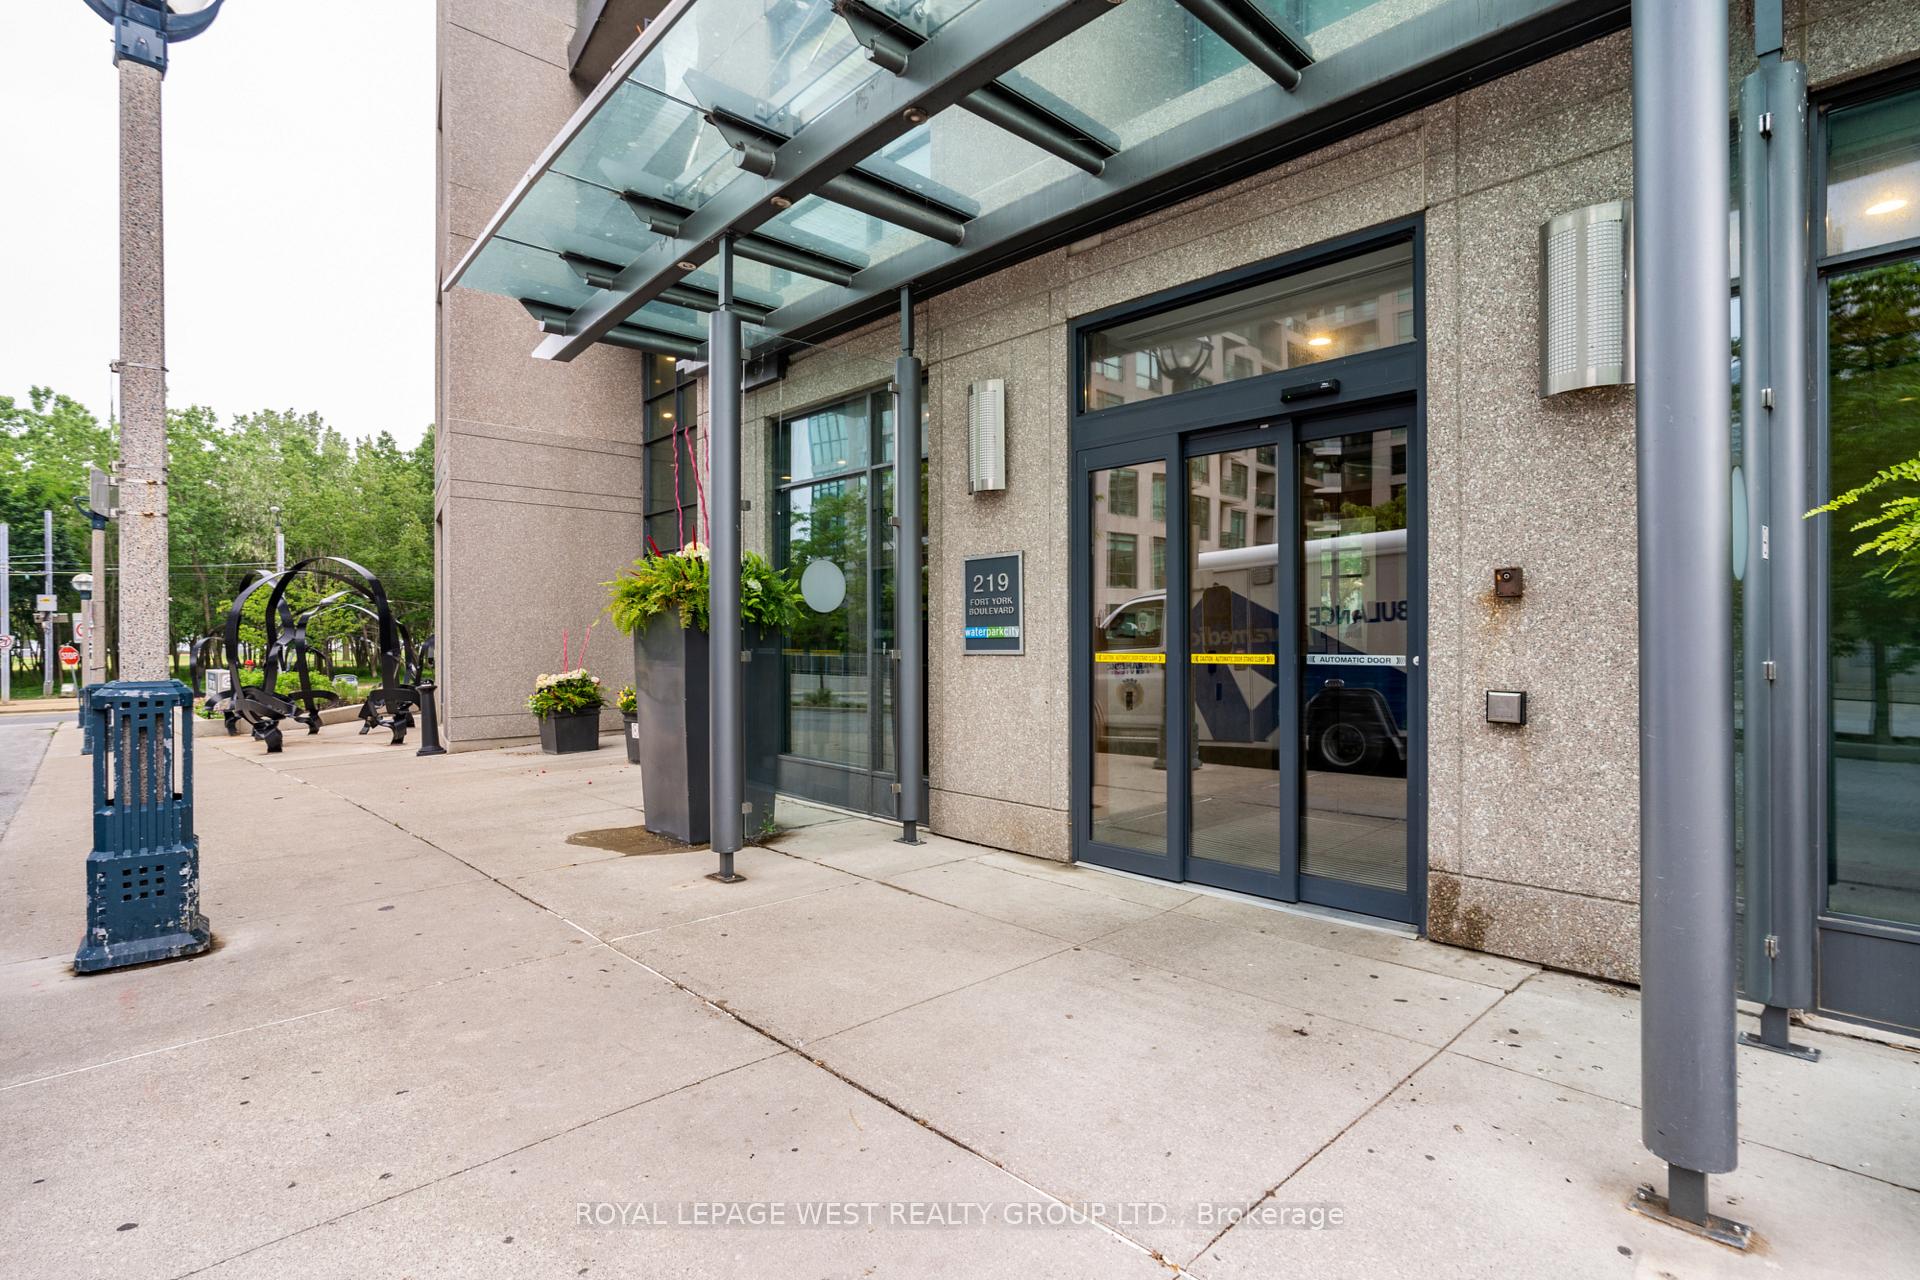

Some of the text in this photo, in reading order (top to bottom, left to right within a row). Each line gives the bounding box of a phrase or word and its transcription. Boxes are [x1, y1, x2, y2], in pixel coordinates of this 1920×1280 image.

[973, 572, 1009, 593] 219
[970, 596, 1013, 606] FORT YORK
[969, 606, 1014, 616] BOULEVARD
[965, 626, 1019, 637] waterparkcity
[1320, 655, 1392, 664] AUTOMATIC DOOR
